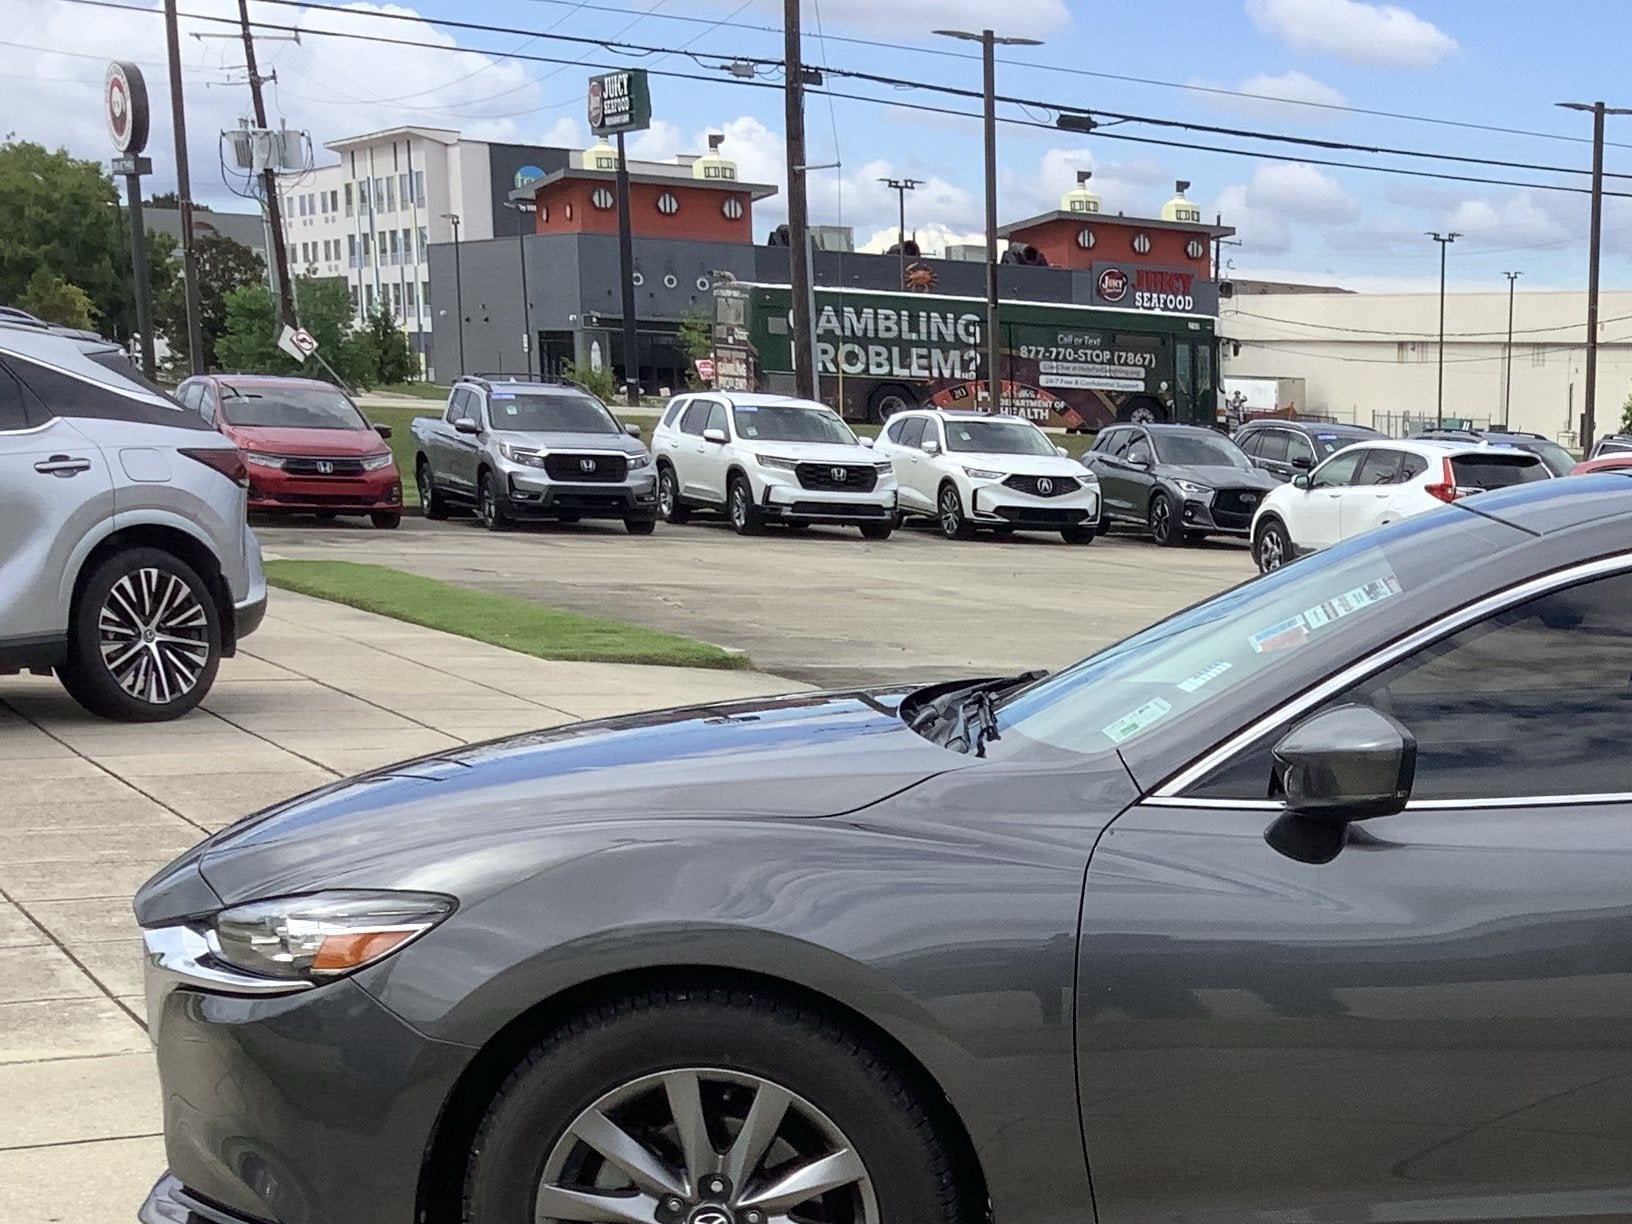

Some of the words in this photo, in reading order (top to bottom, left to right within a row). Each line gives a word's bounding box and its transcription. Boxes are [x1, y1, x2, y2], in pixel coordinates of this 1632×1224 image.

[603, 73, 628, 99] JUICY
[603, 96, 630, 115] SEAFOOD
[1131, 269, 1194, 295] JUICY
[1134, 291, 1194, 311] SEAFOOD
[788, 305, 981, 345] AMBLING
[1058, 334, 1073, 345] Call
[1084, 336, 1101, 346] Text
[1020, 345, 1111, 362] 877-770-STOP
[1113, 351, 1156, 368] (7867)
